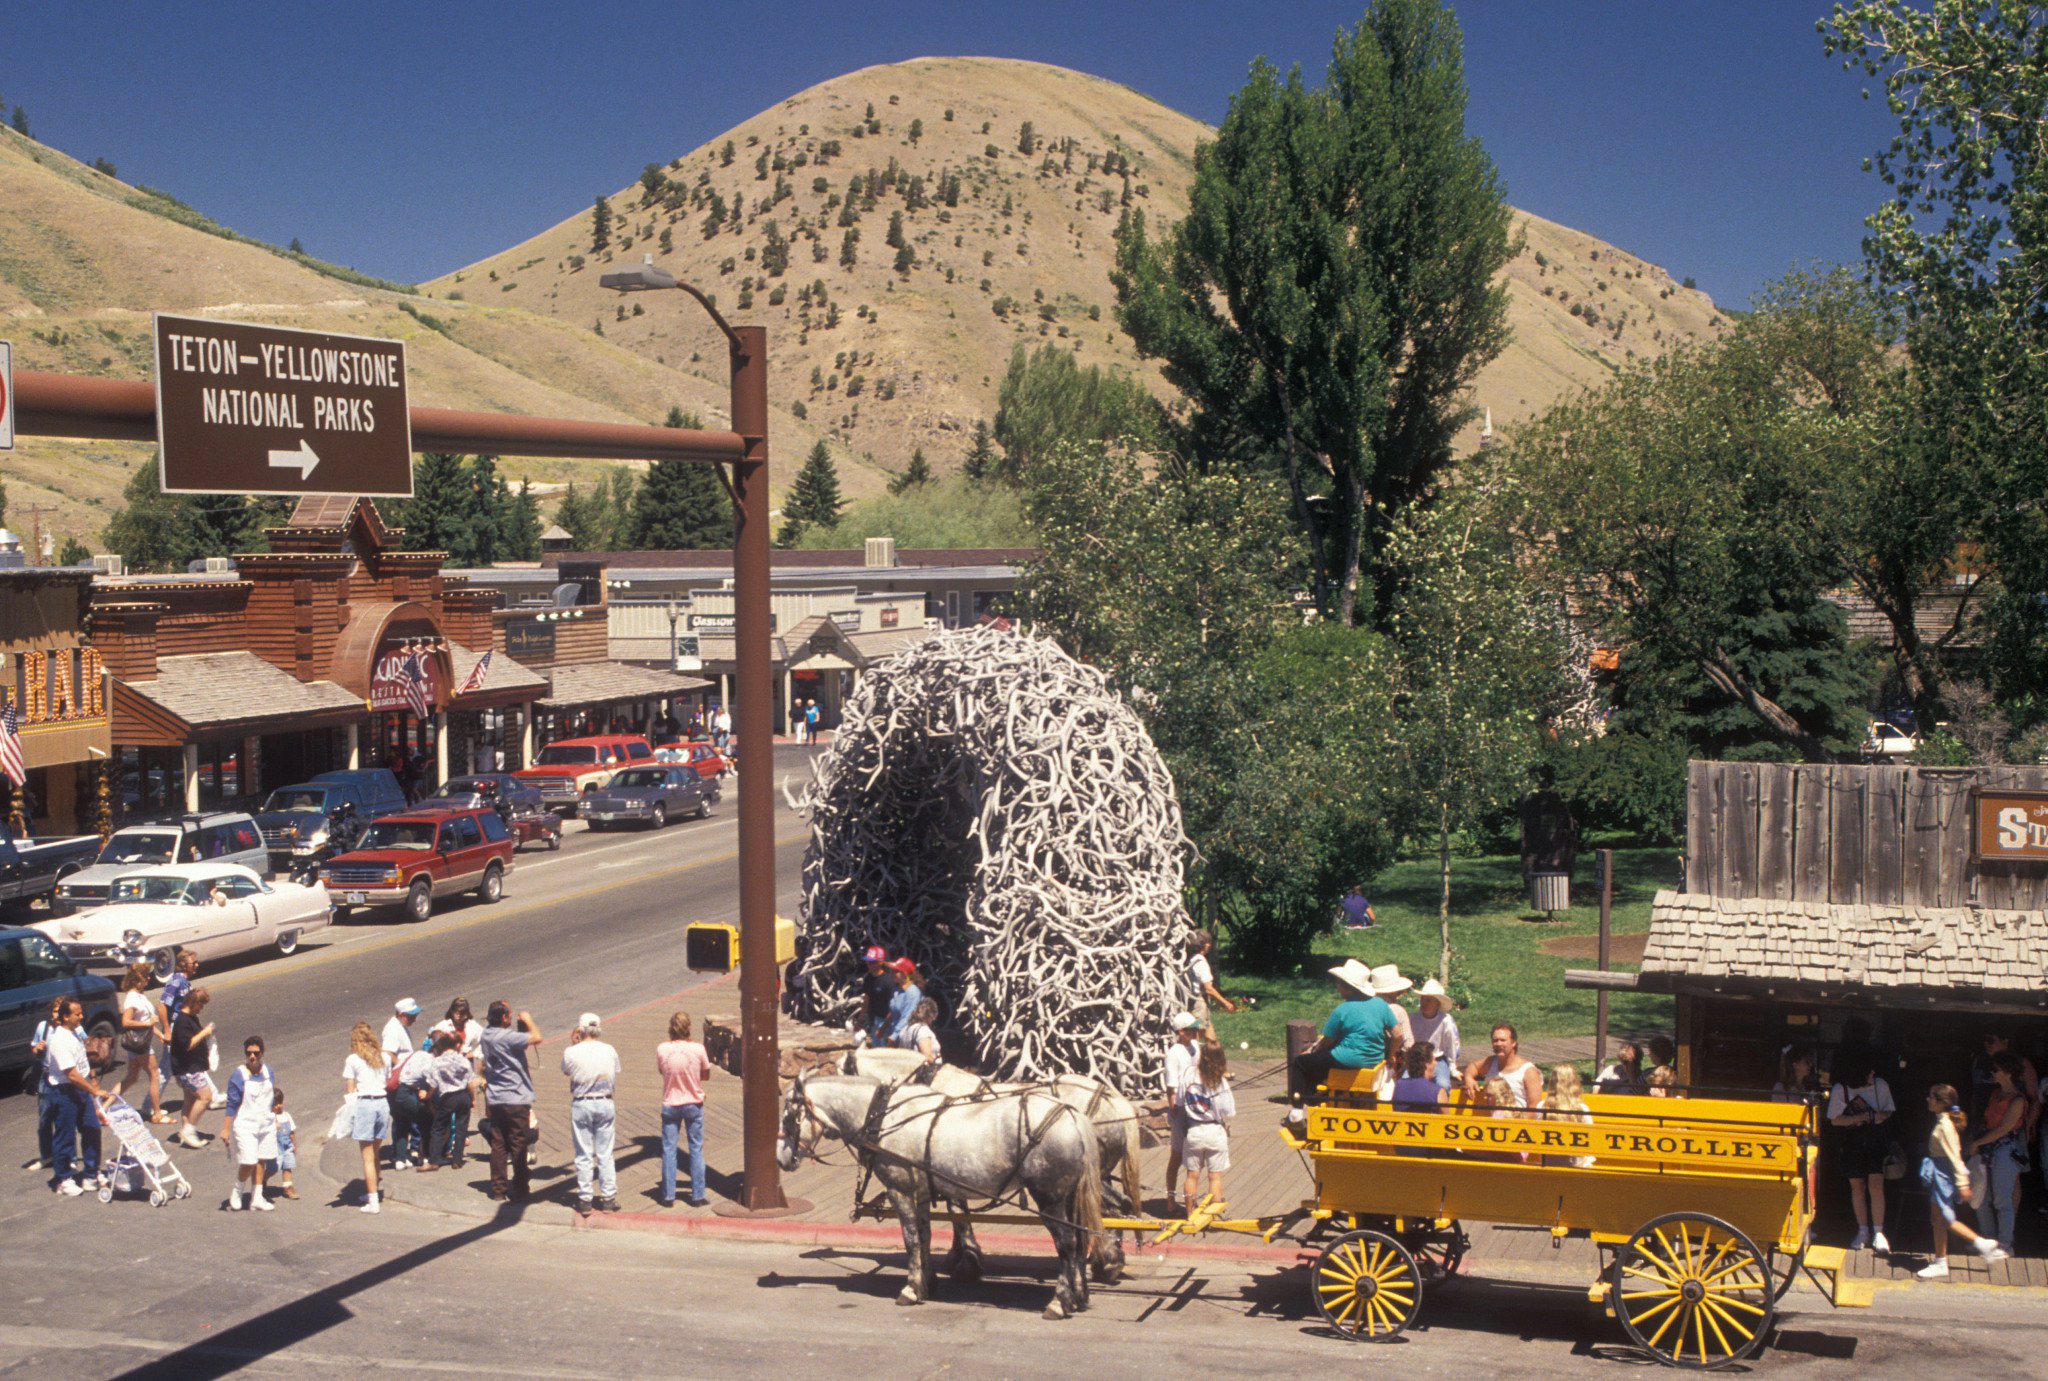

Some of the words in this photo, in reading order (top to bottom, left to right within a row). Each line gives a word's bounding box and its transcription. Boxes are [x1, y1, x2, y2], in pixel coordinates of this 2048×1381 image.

[202, 387, 305, 429] NATIONAL
[314, 396, 376, 433] PARKS
[24, 648, 106, 723] BAR
[1320, 1116, 1429, 1138] TOWN
[1444, 1123, 1590, 1148] SQUARE
[1605, 1133, 1782, 1160] TROLLEY
